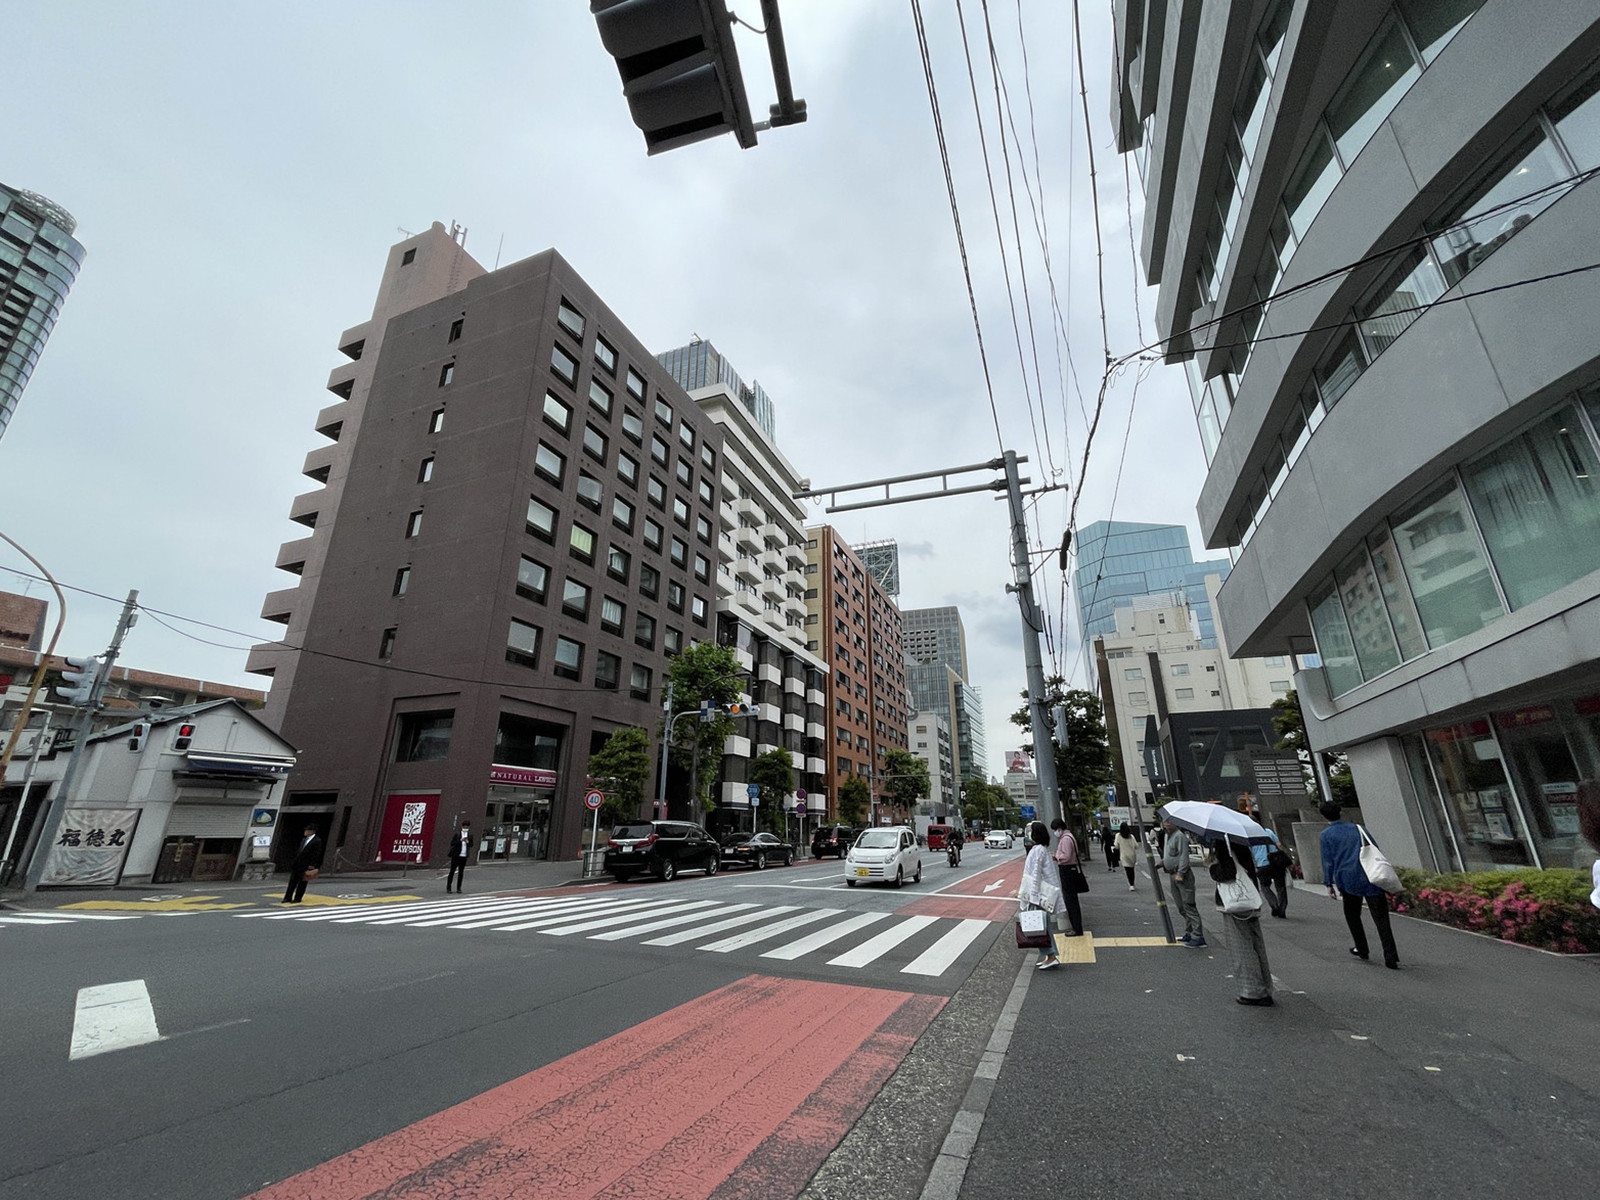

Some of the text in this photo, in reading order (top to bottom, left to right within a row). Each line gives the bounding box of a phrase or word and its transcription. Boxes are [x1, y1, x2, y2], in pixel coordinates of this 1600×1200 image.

[496, 772, 533, 782] NATURAL
[589, 795, 600, 804] 40
[56, 828, 126, 847] 福徳丸
[392, 845, 424, 854] LAWSON
